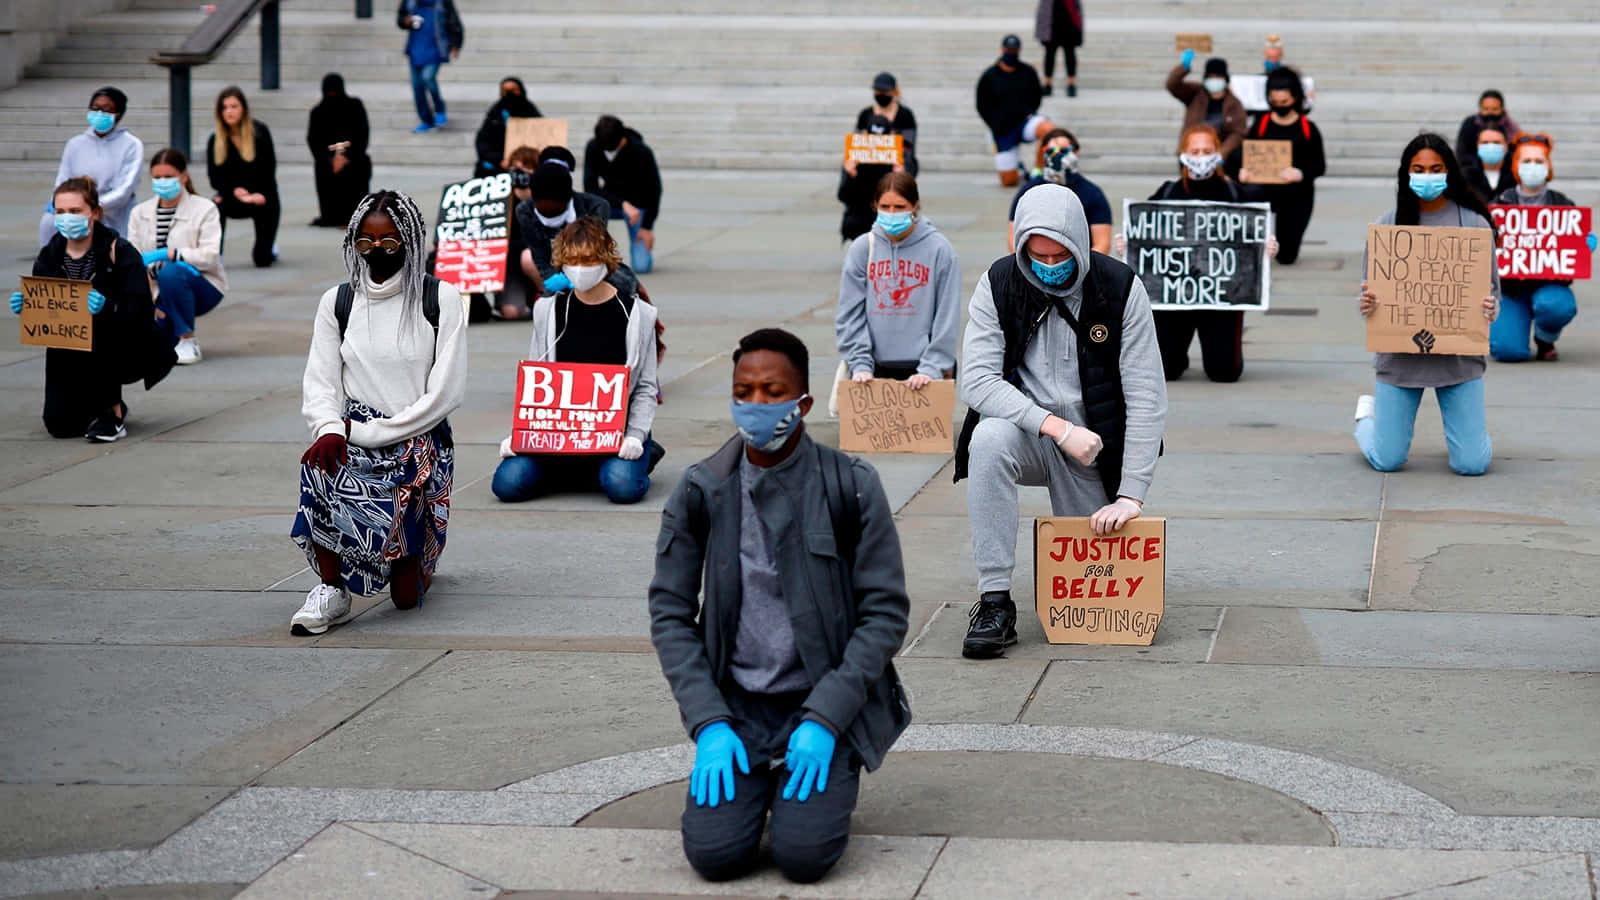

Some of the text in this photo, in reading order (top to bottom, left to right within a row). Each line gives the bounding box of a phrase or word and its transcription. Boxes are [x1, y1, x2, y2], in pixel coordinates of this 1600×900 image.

[442, 173, 512, 209] ACAB
[1126, 211, 1267, 243] WHITE PEOPLE
[1491, 208, 1583, 236] COLOUR
[1374, 229, 1480, 262] NO JUSTICE
[1503, 234, 1558, 249] IS NOT A
[1138, 247, 1236, 277] MUST DO
[1373, 258, 1473, 283] NO PEACE
[1495, 249, 1577, 276] CRIME
[24, 283, 80, 298] WHITE
[1163, 277, 1231, 305] MORE
[1395, 281, 1470, 308] PROSECUTE
[23, 299, 78, 312] SILENCE
[1384, 304, 1467, 330] THE POLICE
[24, 324, 88, 341] VIOLENCE
[520, 366, 626, 410] BLM
[848, 383, 930, 414] BLACK
[519, 407, 617, 423] HOW MANY
[528, 421, 596, 431] MORE WILL BE
[852, 409, 907, 435] LIVES
[520, 430, 566, 450] TREATED
[571, 429, 622, 449] THEY DON'T
[869, 417, 948, 450] MATTER!
[1049, 536, 1160, 562] JUSTICE
[1084, 564, 1115, 578] FOR
[1052, 576, 1144, 599] BELLY
[1049, 605, 1160, 637] MUJINGA
